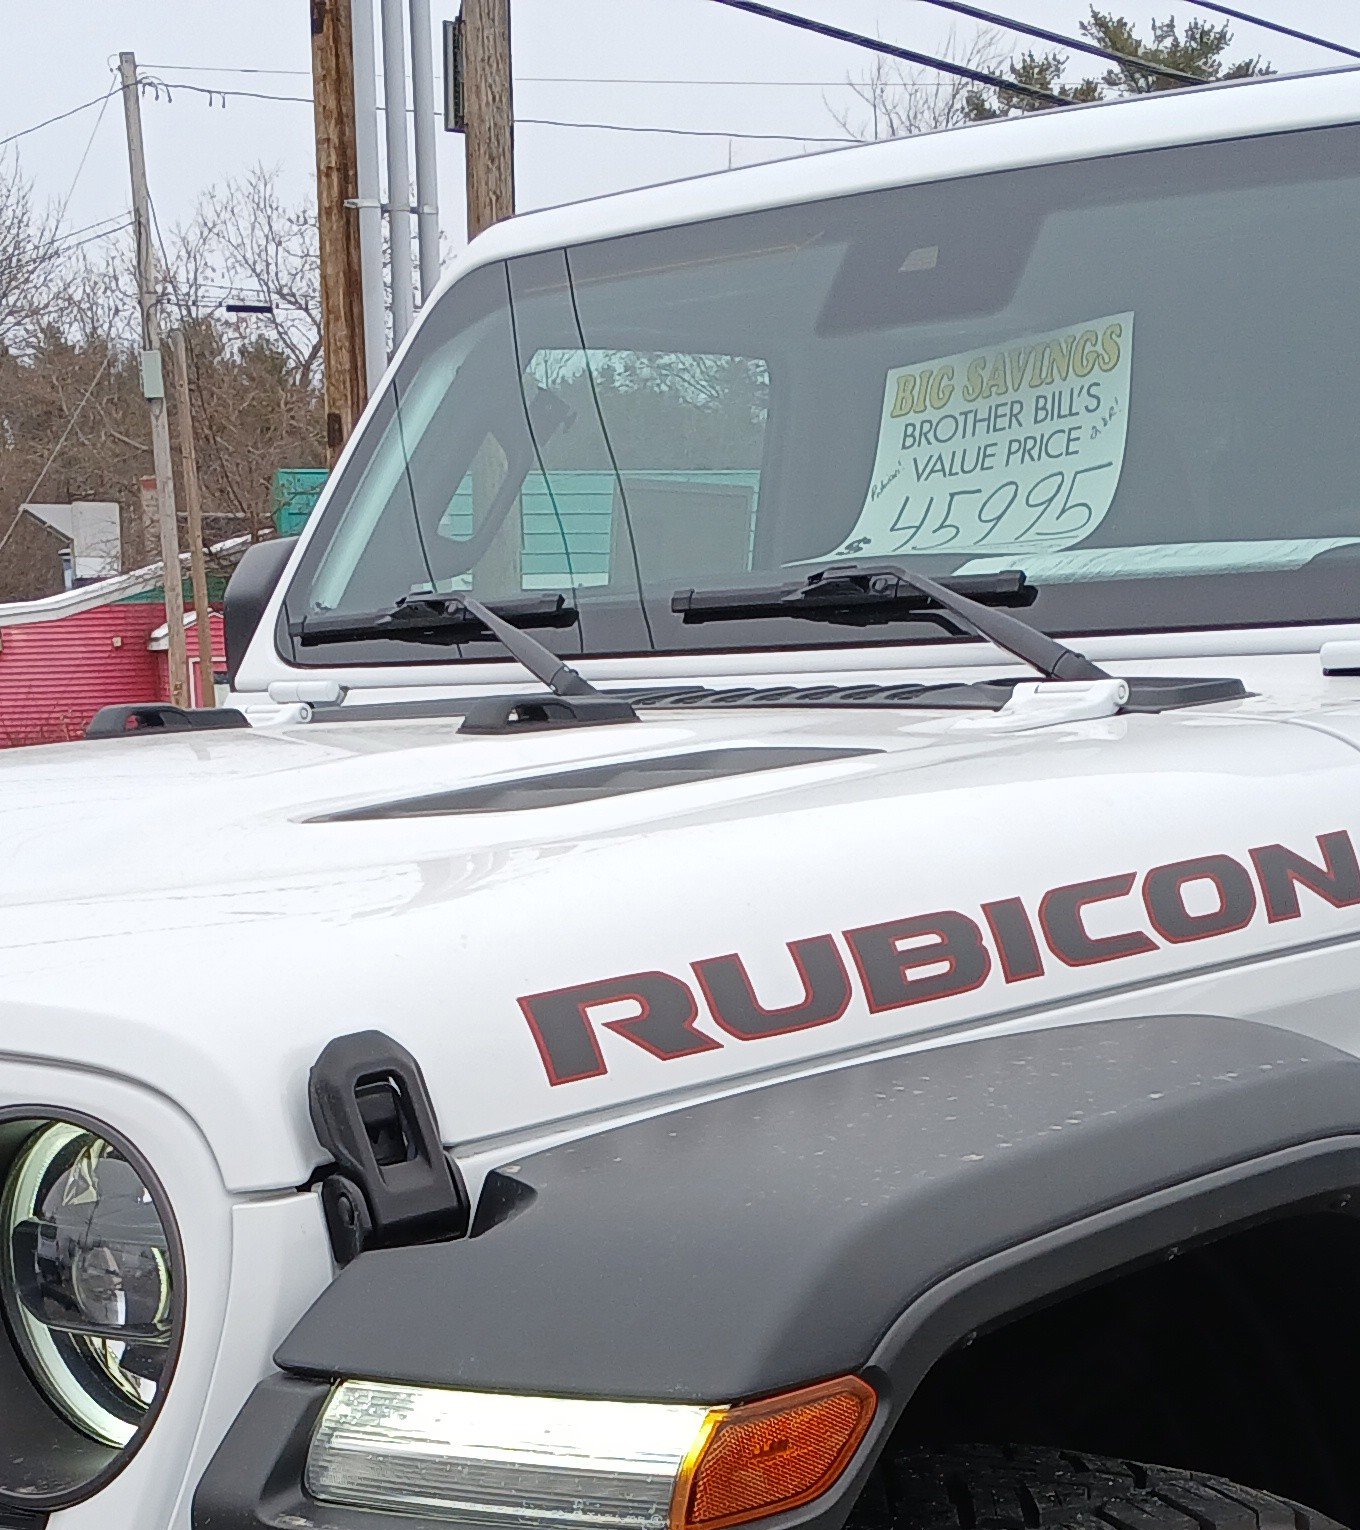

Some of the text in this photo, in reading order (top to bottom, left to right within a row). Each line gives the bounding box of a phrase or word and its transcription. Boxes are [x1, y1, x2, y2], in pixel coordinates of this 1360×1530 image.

[890, 323, 1123, 418] BIG SAVINGS
[901, 381, 1102, 450] BROTHER BILL'S
[912, 425, 1083, 482] VALUE PRICE
[889, 461, 1114, 553] 45995
